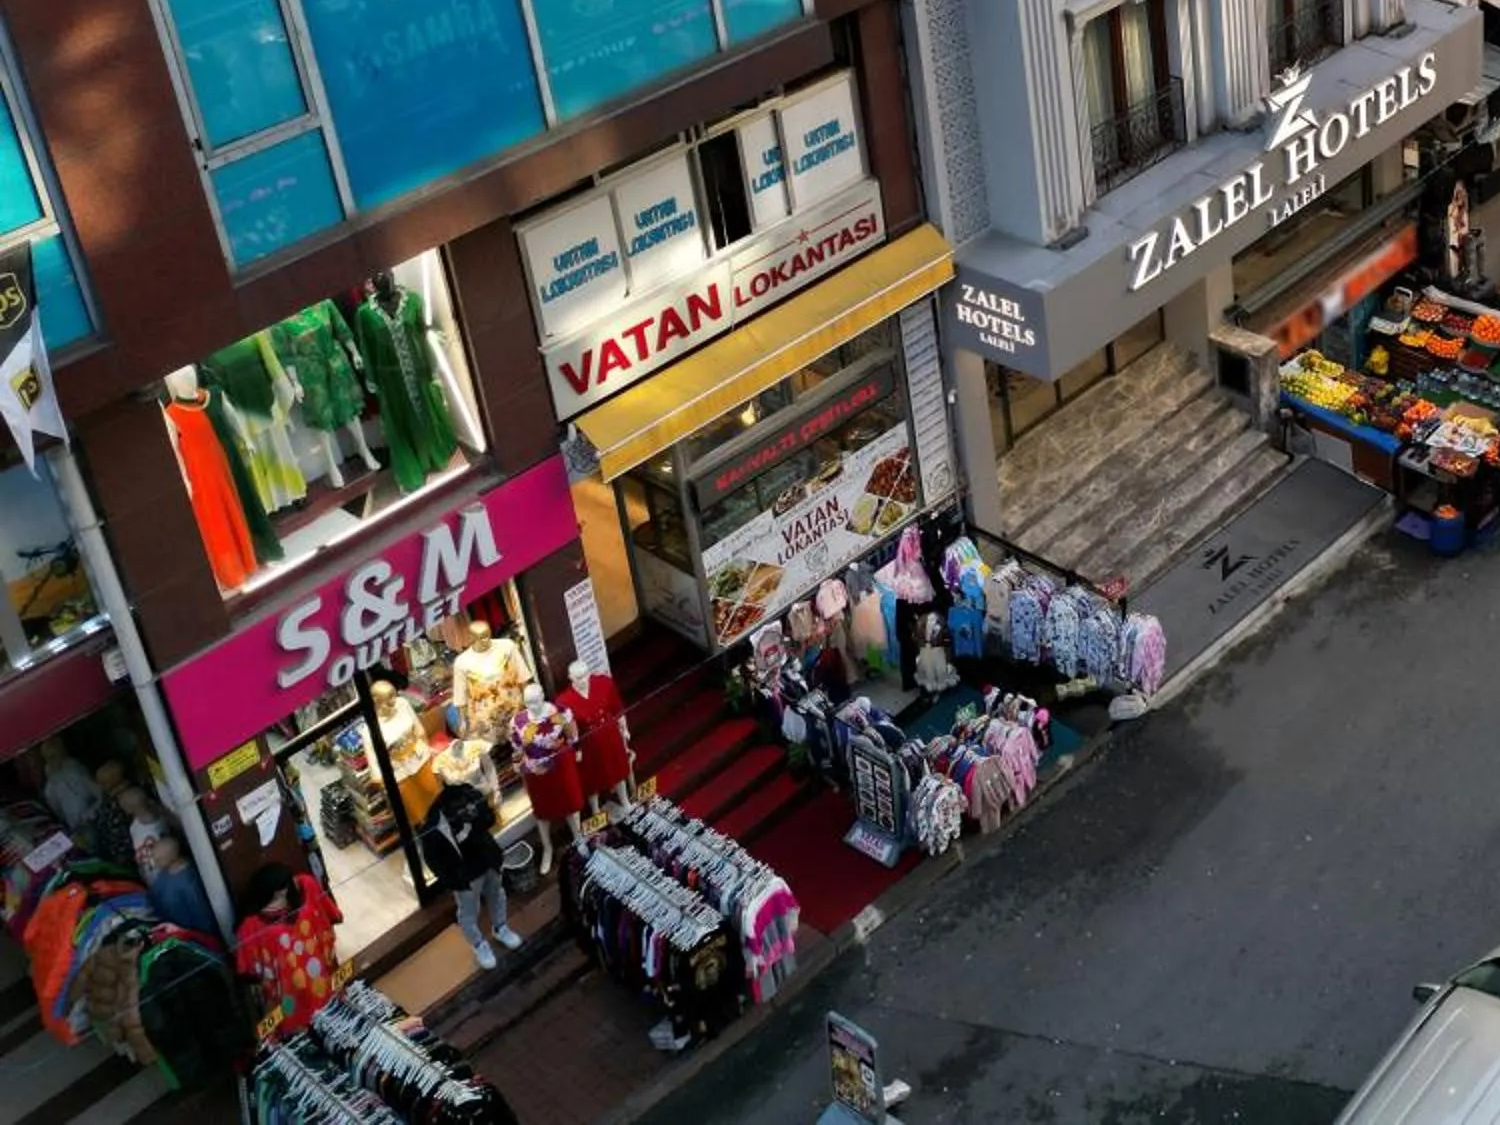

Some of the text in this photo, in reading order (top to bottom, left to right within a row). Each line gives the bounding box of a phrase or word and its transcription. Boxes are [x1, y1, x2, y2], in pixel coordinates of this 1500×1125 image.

[1128, 52, 1438, 292] ZALEL HOTELS
[559, 213, 877, 396] VATAN LOKANTASI
[956, 303, 1036, 347] HOTELS
[961, 284, 1025, 322] ZALEL
[781, 495, 839, 544] VATAN
[328, 585, 467, 688] OUTLET
